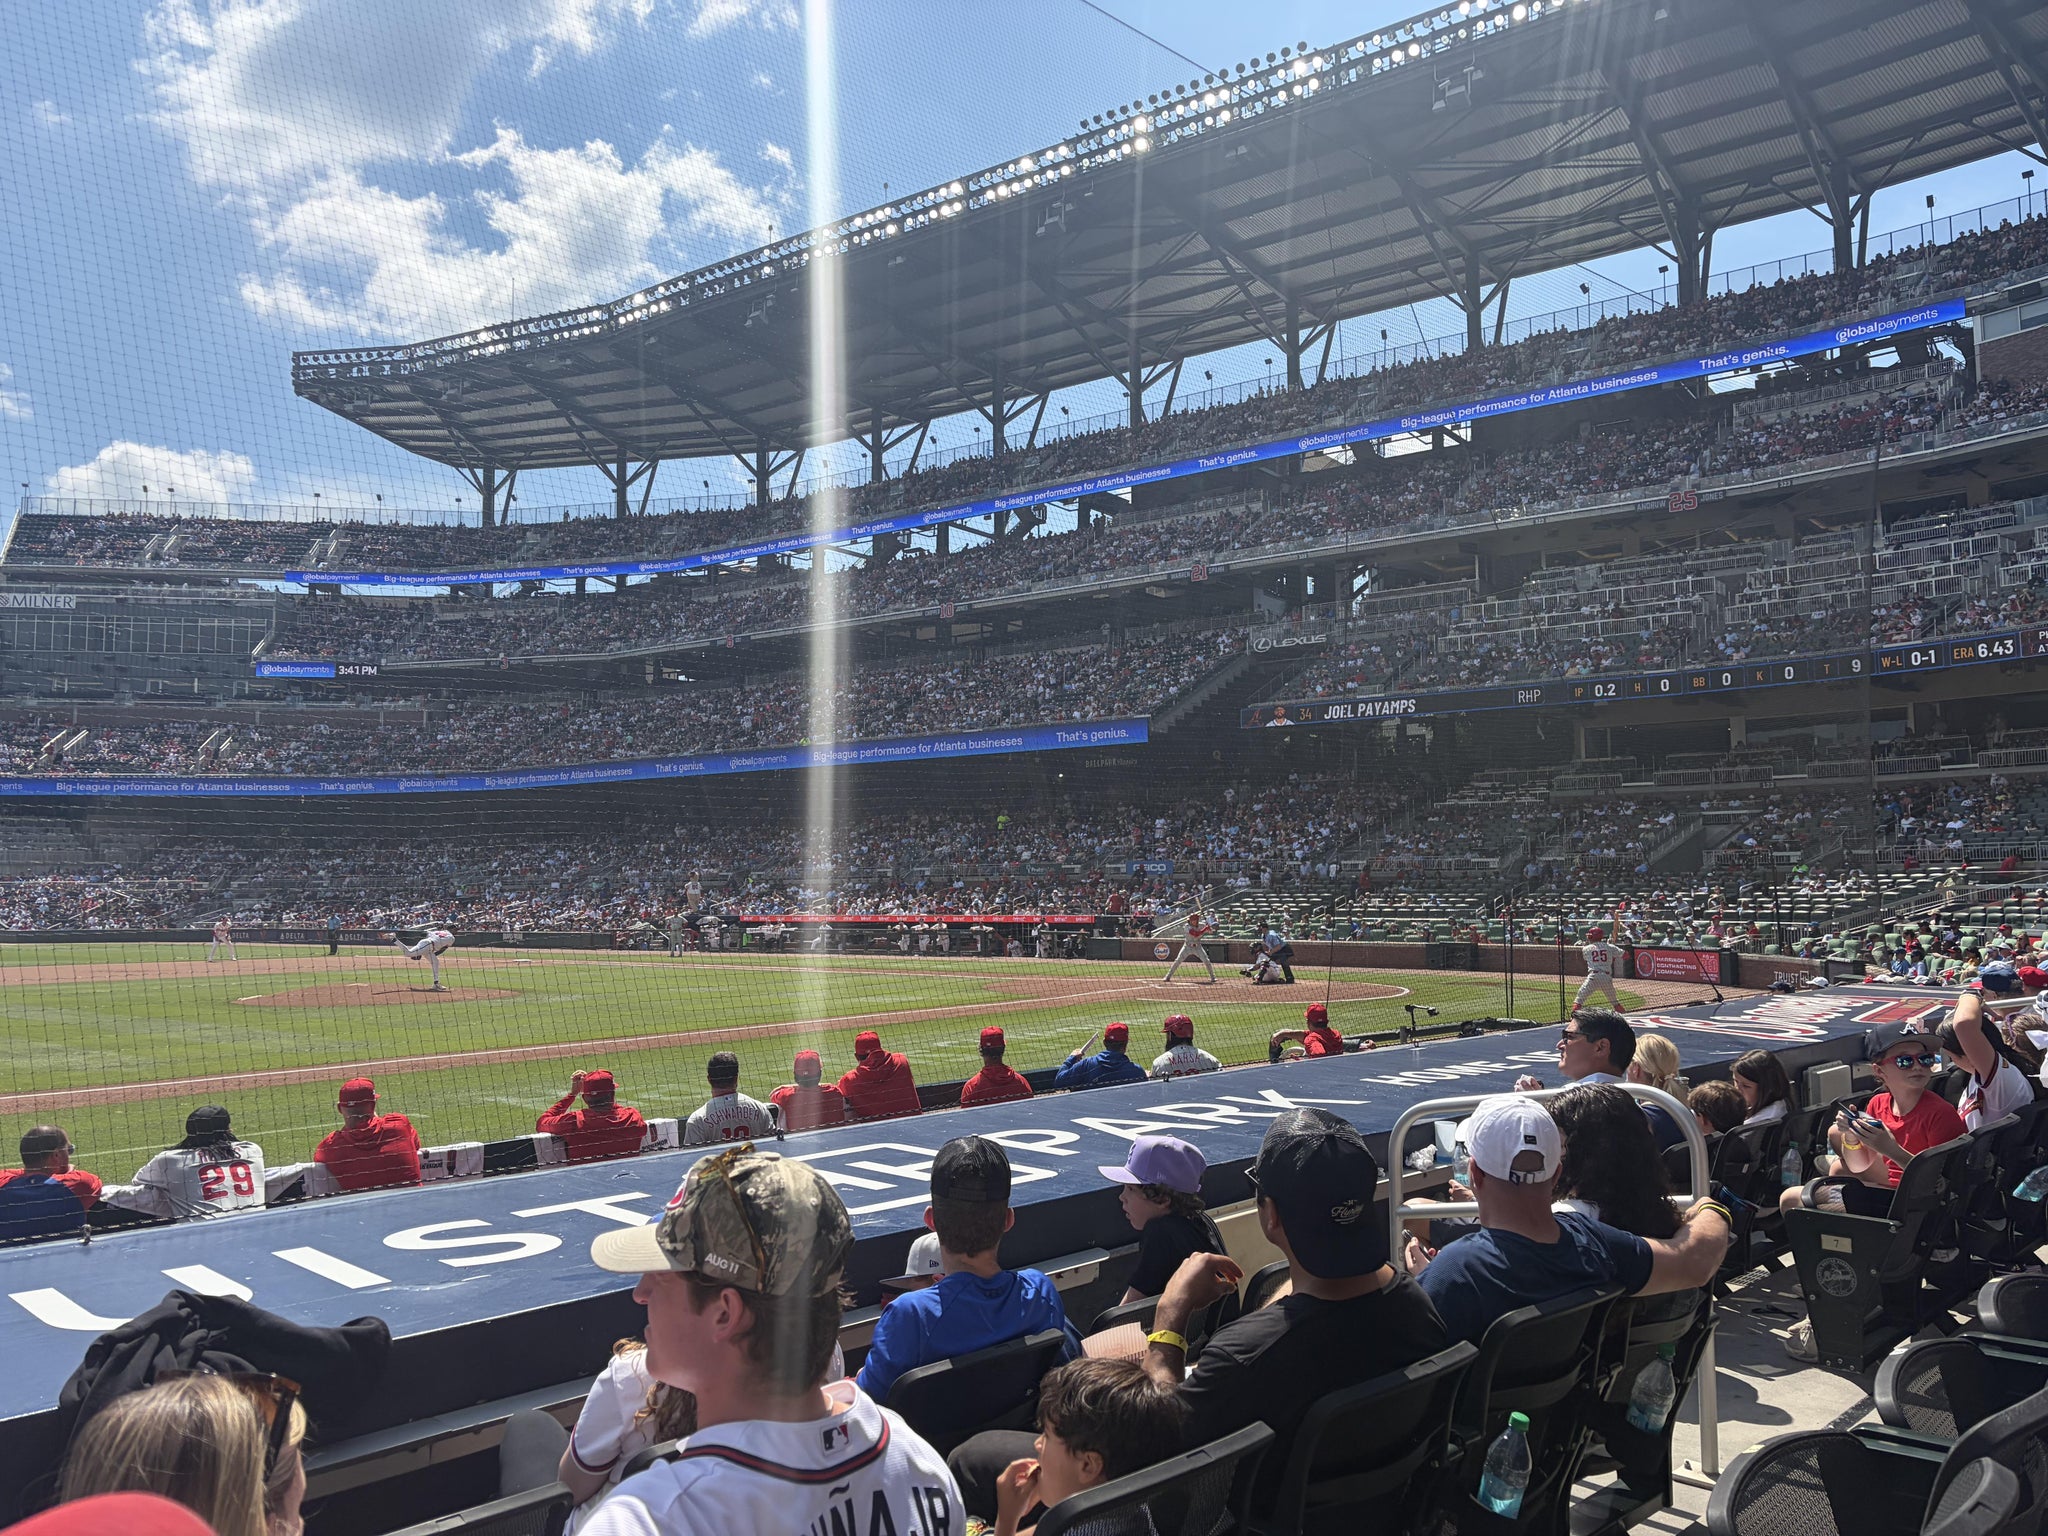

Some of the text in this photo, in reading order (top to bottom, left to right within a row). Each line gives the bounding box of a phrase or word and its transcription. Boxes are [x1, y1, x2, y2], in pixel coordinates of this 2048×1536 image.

[1699, 345, 1790, 371] That's genius.
[1401, 371, 1659, 429] Big-league performance for Atlanta businesses
[1199, 450, 1258, 468] That's genius.
[994, 466, 1172, 509] Big-league performance for Atlanta businesses
[1669, 489, 1698, 512] 25
[851, 521, 895, 535] That's genius.
[731, 545, 767, 560] performance
[768, 542, 777, 551] for
[778, 539, 799, 550] Atlanta
[426, 574, 468, 584] performance
[479, 571, 503, 580] Atlanta
[503, 569, 541, 578] businesses
[1191, 565, 1208, 582] 21
[12, 595, 73, 608] MILNER
[940, 602, 954, 619] 10
[1273, 634, 1327, 648] LEXUS
[1953, 639, 2014, 660] ERA 6.43
[1823, 658, 1861, 675] T 9
[1881, 649, 1936, 668] W-L 0-1
[338, 665, 378, 676] 3:41 PM
[1756, 665, 1794, 681] K 0
[1634, 678, 1670, 693] H 0
[1693, 672, 1732, 687] BB 0
[1518, 688, 1541, 704] RHP
[1574, 683, 1617, 698] IP 0.2
[1299, 707, 1313, 721] 34
[1323, 703, 1354, 720] JOEL
[1358, 698, 1416, 718] PAYAMPS
[1056, 728, 1129, 743] That's genius.
[813, 736, 1023, 763] Big-league performance for Atlanta businesses
[560, 772, 570, 781] for
[570, 769, 594, 780] Atlanta
[594, 767, 633, 778] businesses
[656, 761, 705, 774] That's genius.
[56, 782, 111, 793] Big-league
[113, 783, 179, 793] performance
[181, 782, 195, 791] for
[198, 782, 233, 792] Atlanta
[235, 782, 290, 792] businesses
[320, 781, 375, 792] That's genius.
[1155, 947, 1170, 956] Gulf
[1591, 950, 1607, 963] 25
[1774, 971, 1799, 985] TRUIST
[1360, 1060, 1532, 1087] HOME
[703, 1105, 760, 1129] SCHWARBER
[982, 1089, 1372, 1156] PARK
[198, 1161, 255, 1201] 29
[1833, 1239, 1839, 1248] 7
[705, 1252, 740, 1274] AUG 11
[910, 1487, 949, 1536] JR
